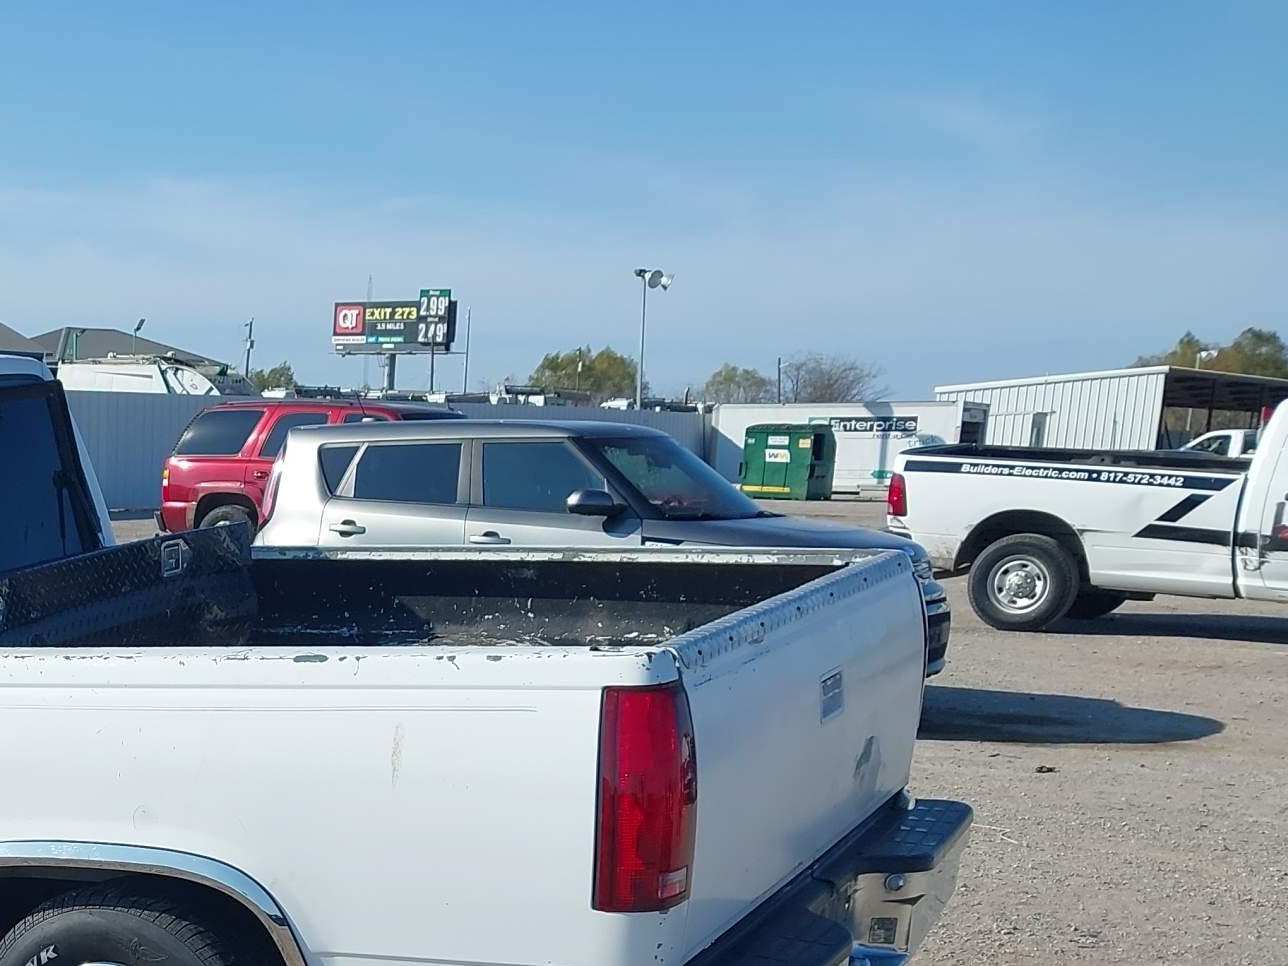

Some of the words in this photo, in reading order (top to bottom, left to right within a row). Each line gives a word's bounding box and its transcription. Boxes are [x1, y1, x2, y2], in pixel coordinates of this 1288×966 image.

[339, 309, 360, 329] QT
[365, 308, 392, 320] EXIT
[394, 307, 417, 320] 273
[830, 417, 917, 433] Enterprise
[960, 463, 1089, 481] Builders-Electric.com
[1100, 471, 1185, 487] 817-572-3442
